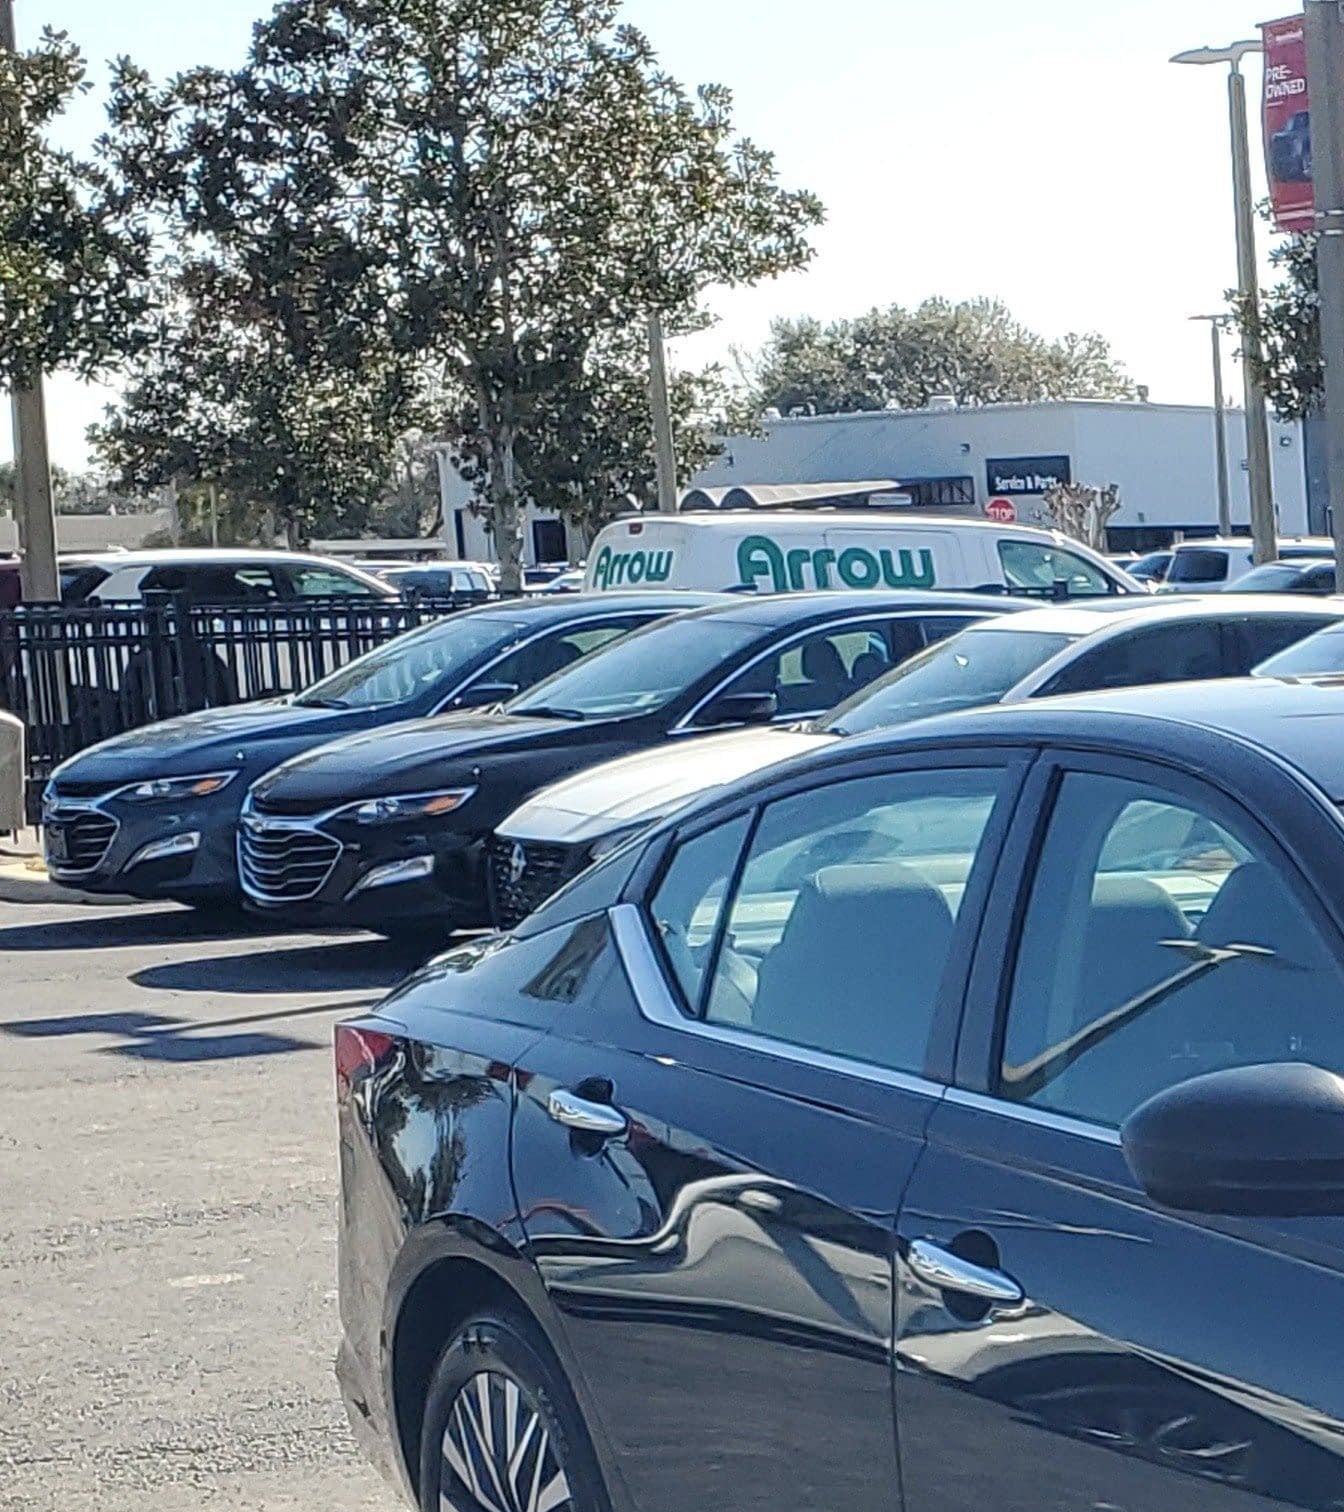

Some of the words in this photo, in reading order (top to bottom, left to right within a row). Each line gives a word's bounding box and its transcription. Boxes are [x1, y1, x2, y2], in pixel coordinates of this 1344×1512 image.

[1266, 64, 1293, 80] PRE-
[1266, 78, 1306, 99] OWNED
[987, 507, 1014, 521] STOP
[594, 545, 674, 591] Arrow
[736, 534, 937, 591] Arrow
